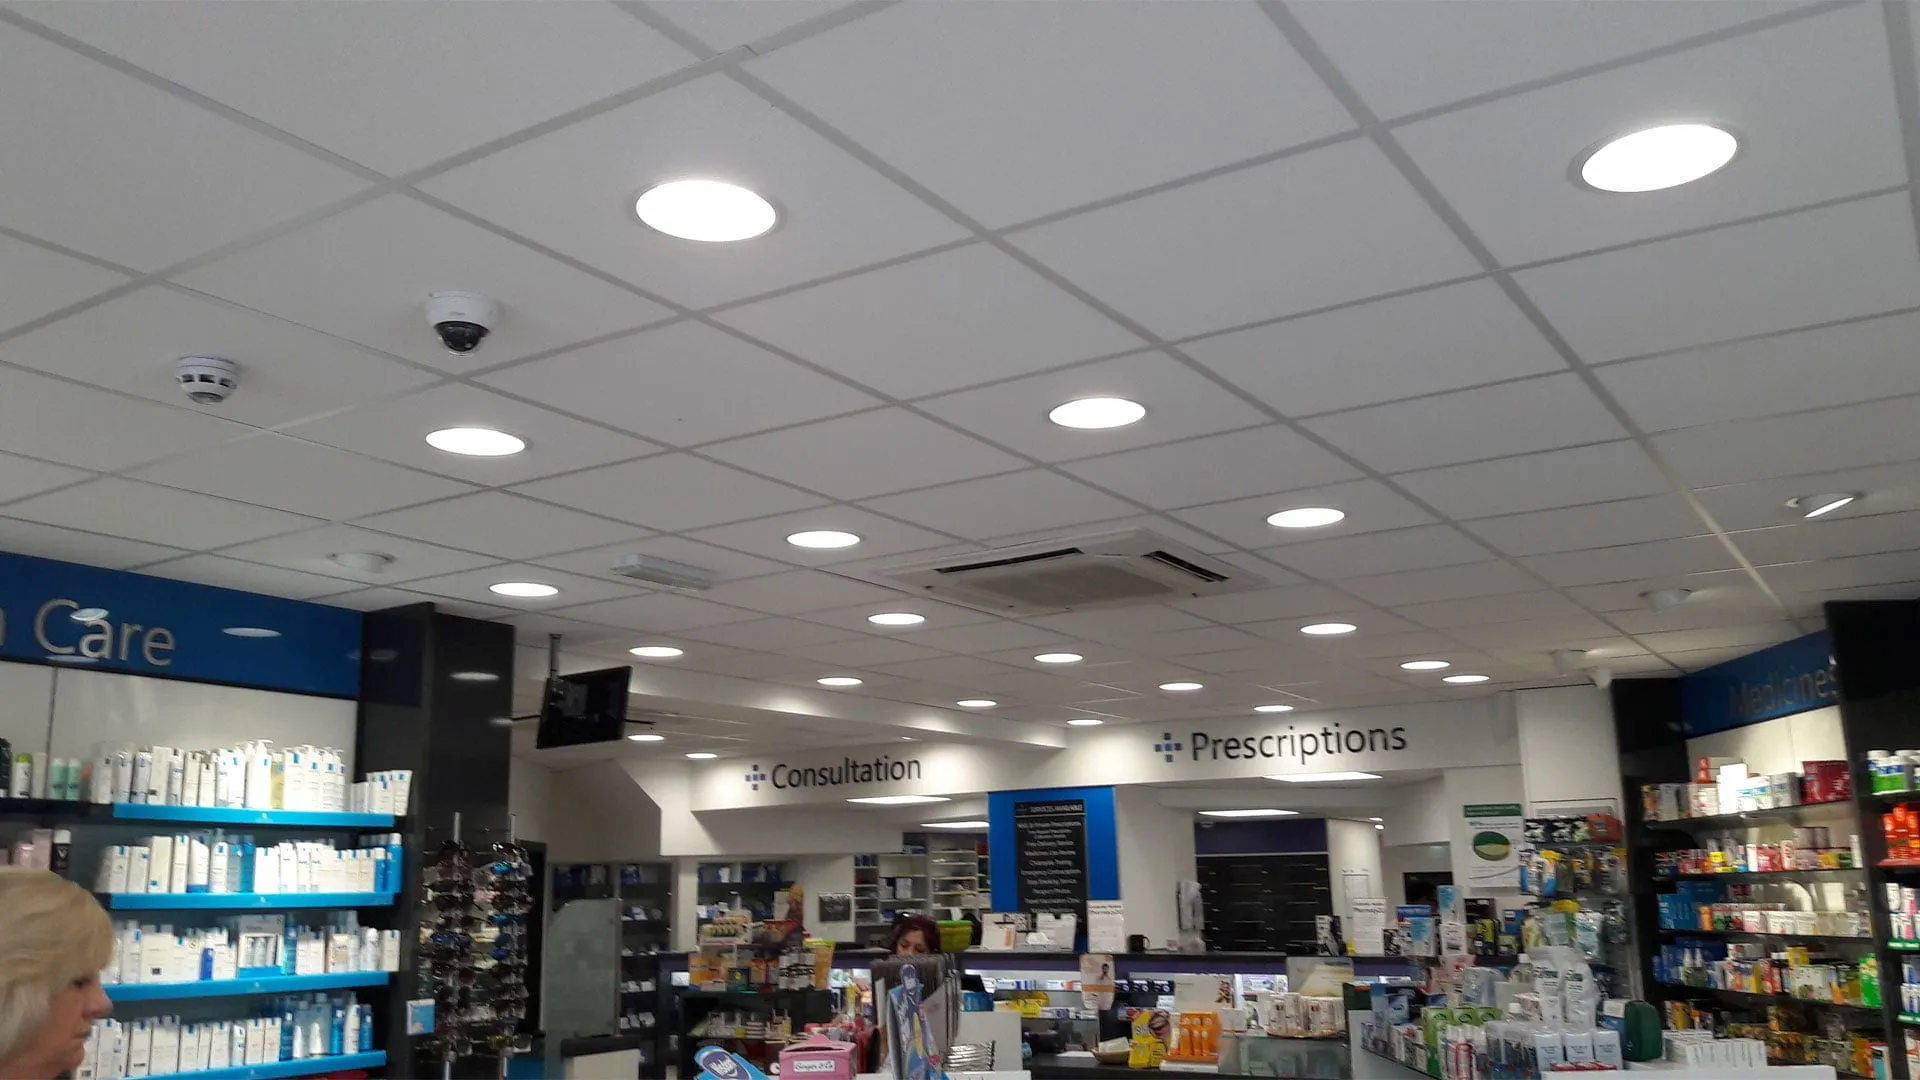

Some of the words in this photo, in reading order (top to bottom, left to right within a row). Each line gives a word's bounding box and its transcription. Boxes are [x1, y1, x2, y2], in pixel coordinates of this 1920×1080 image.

[34, 598, 175, 666] Care
[1730, 662, 1841, 718] Medicines
[1192, 722, 1408, 765] Prescriptions
[772, 755, 922, 789] Consultation
